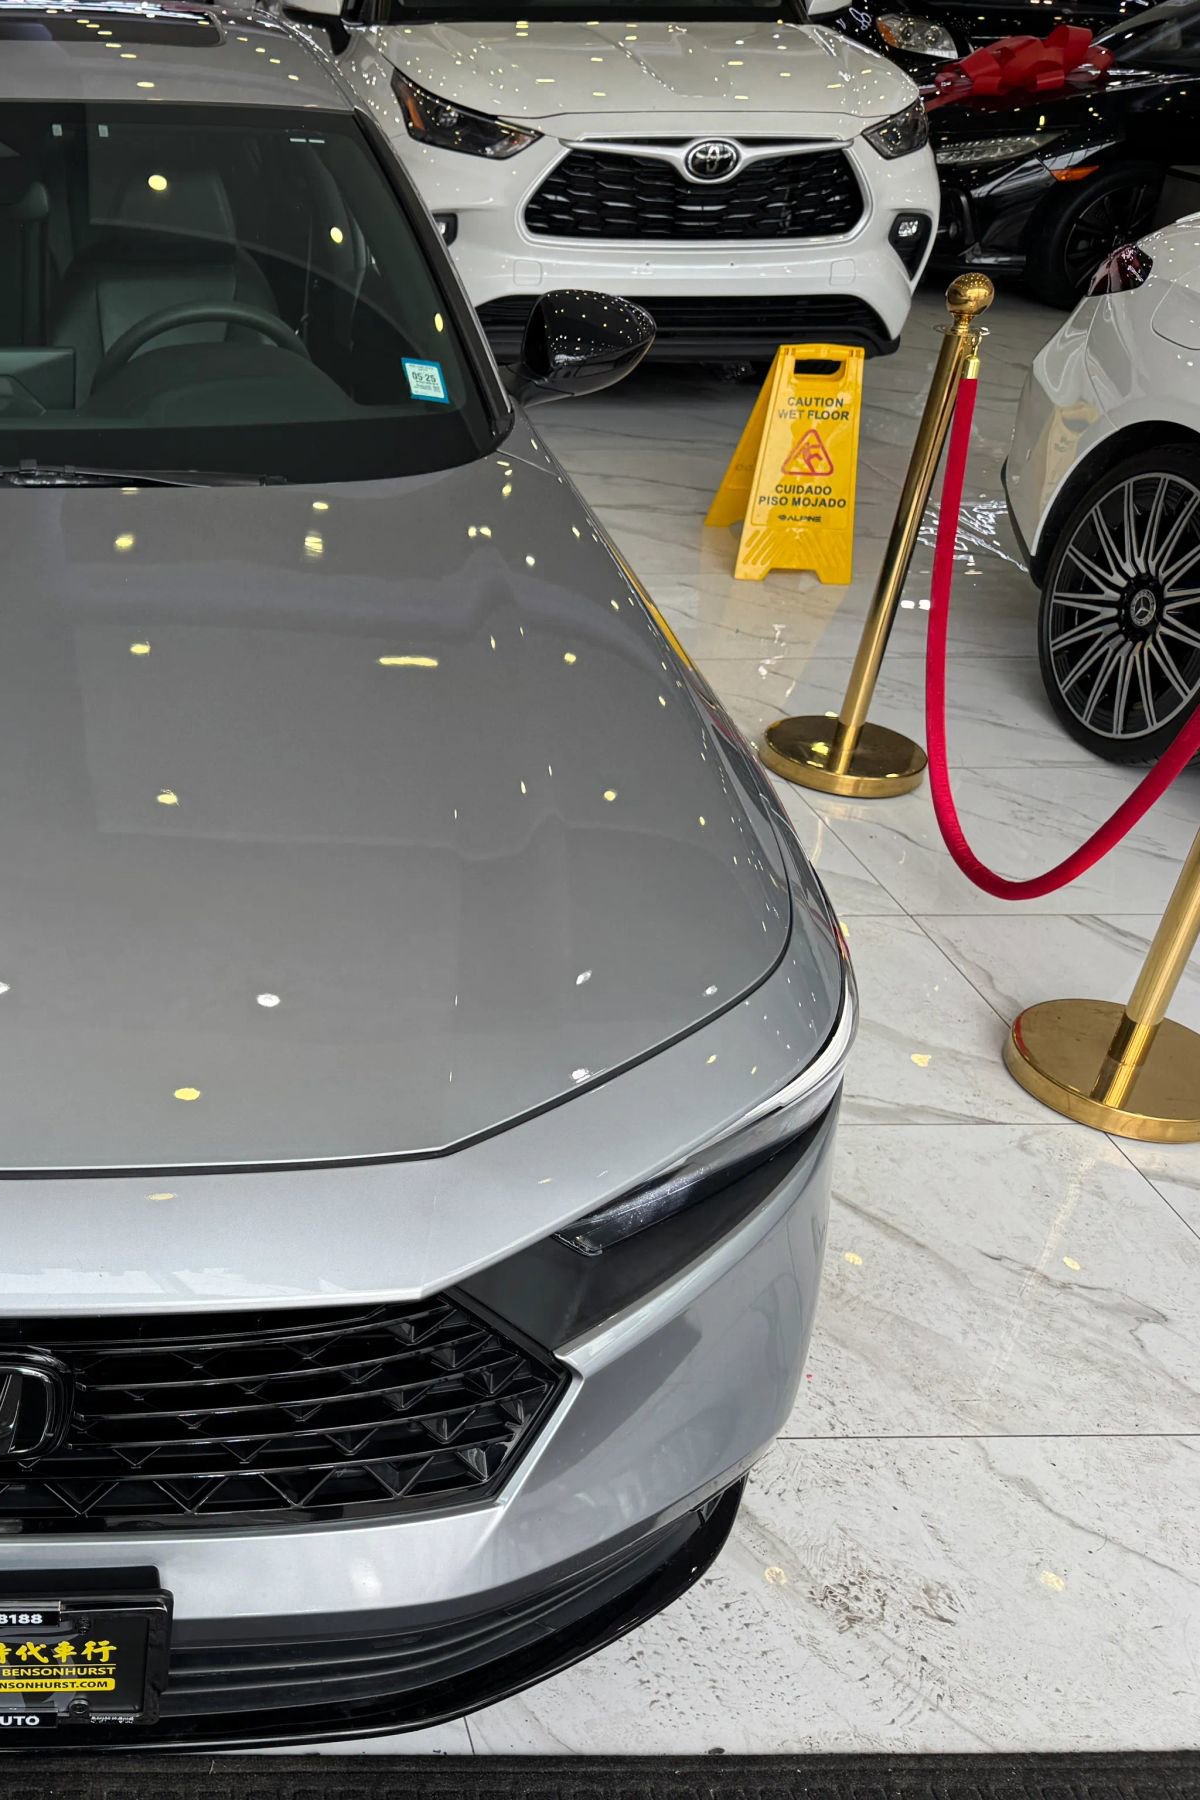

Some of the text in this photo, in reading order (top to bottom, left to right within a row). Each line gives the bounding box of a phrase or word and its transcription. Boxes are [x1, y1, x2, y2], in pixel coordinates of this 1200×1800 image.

[787, 397, 844, 408] CAUTION
[777, 409, 850, 421] WET FLOOR
[775, 484, 832, 495] CUIDADO
[758, 496, 846, 508] PISO MOJADO
[2, 1667, 116, 1677] BENSONHURST
